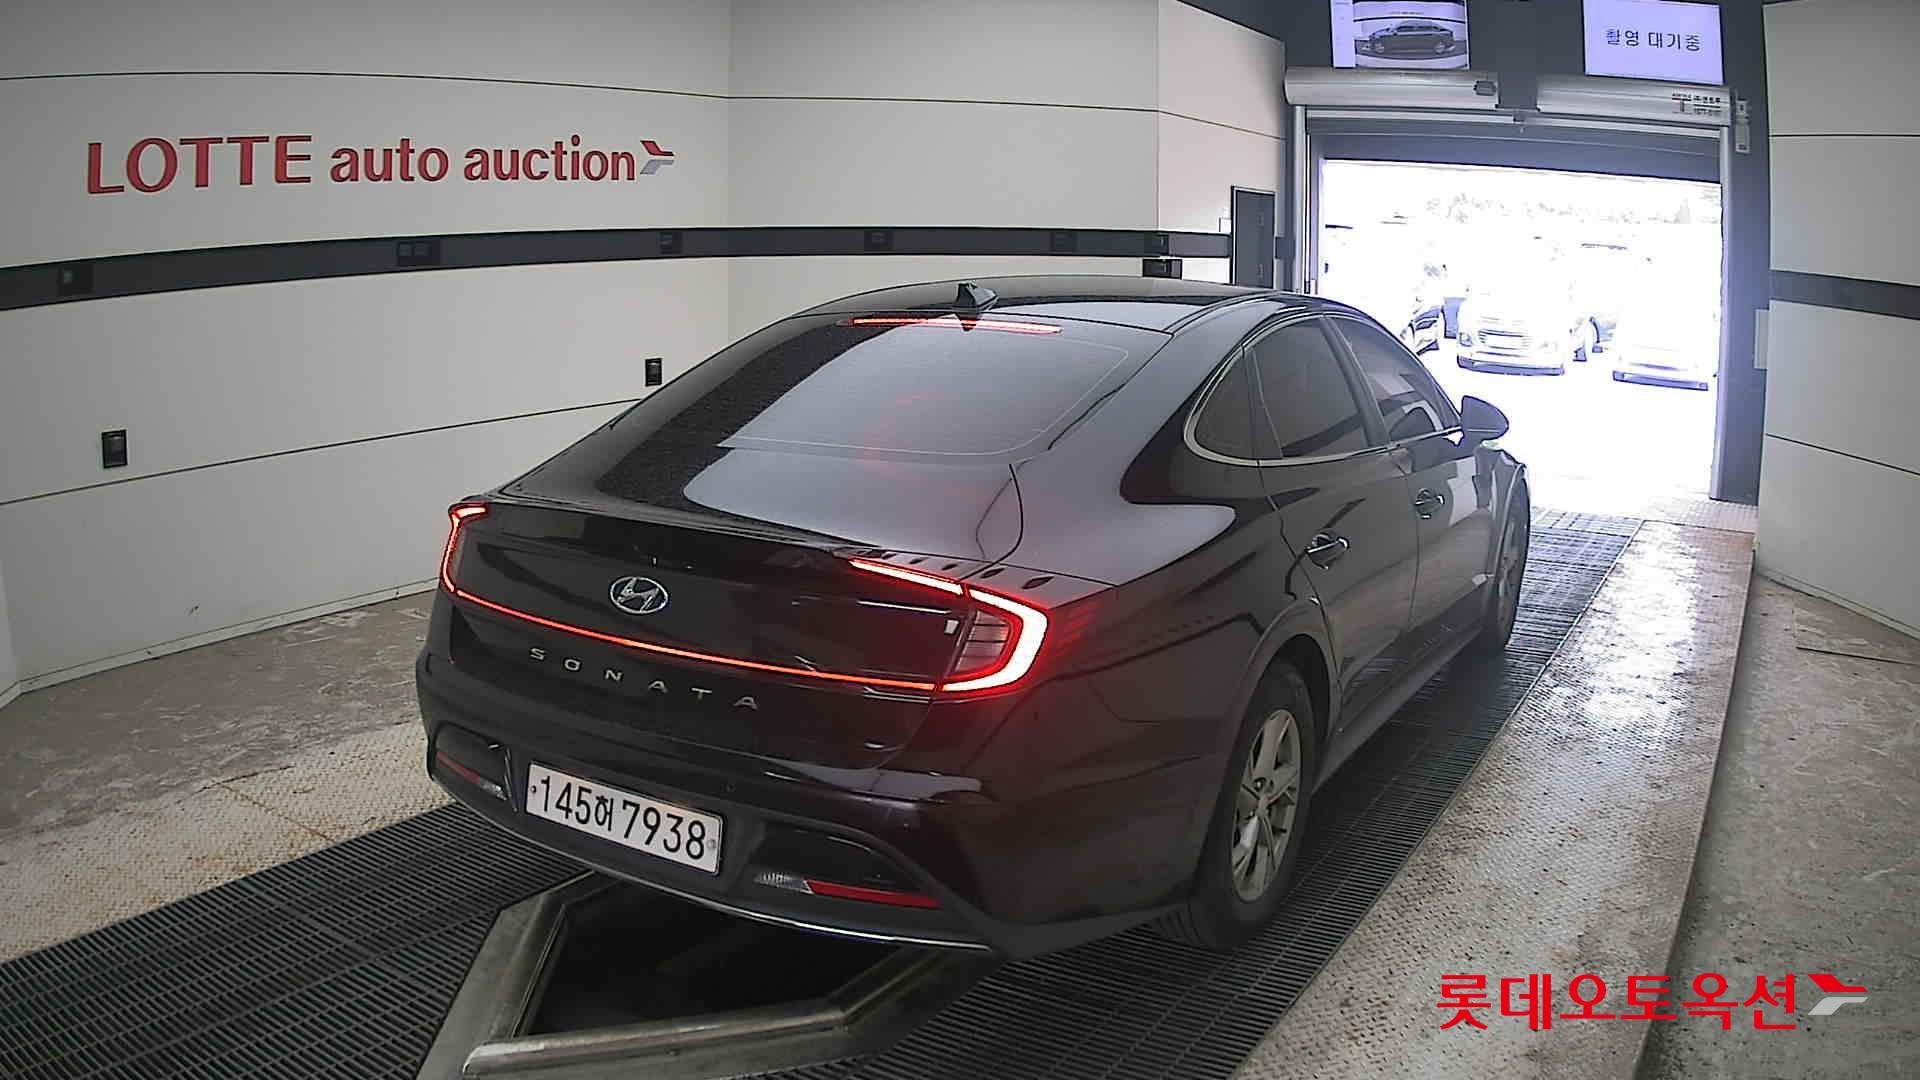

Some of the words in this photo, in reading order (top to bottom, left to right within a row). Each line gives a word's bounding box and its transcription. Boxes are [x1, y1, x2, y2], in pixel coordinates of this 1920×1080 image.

[87, 134, 312, 194] LOTTE
[329, 137, 449, 183] auto
[463, 134, 636, 182] auction
[529, 647, 759, 711] SONATA
